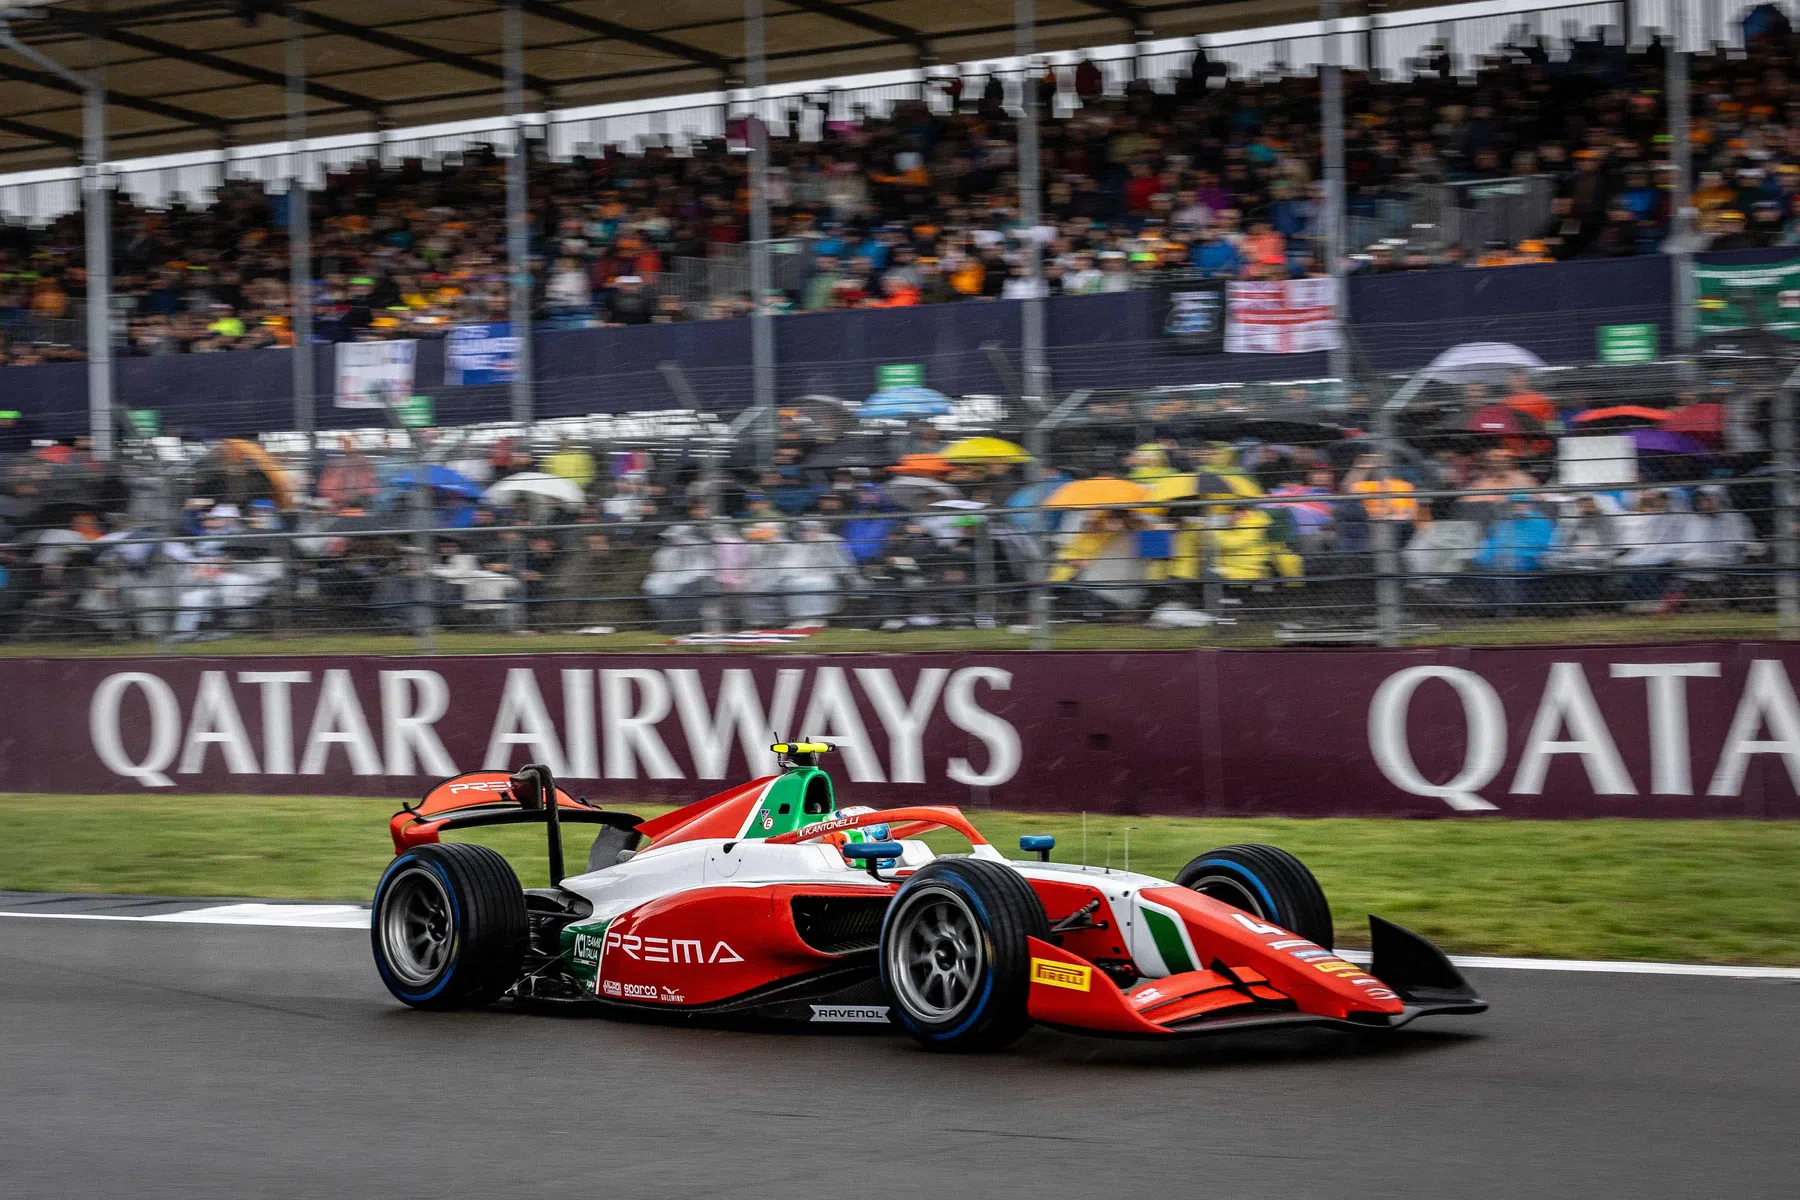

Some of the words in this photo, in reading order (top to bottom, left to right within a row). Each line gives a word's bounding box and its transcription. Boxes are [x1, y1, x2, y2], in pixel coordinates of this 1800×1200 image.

[89, 669, 462, 787] QATAR
[482, 666, 1022, 786] AIRWAYS
[606, 932, 745, 964] PREMA
[1037, 963, 1085, 986] PIRELLI
[623, 983, 657, 998] sparco
[818, 1009, 883, 1018] RAVENOL
